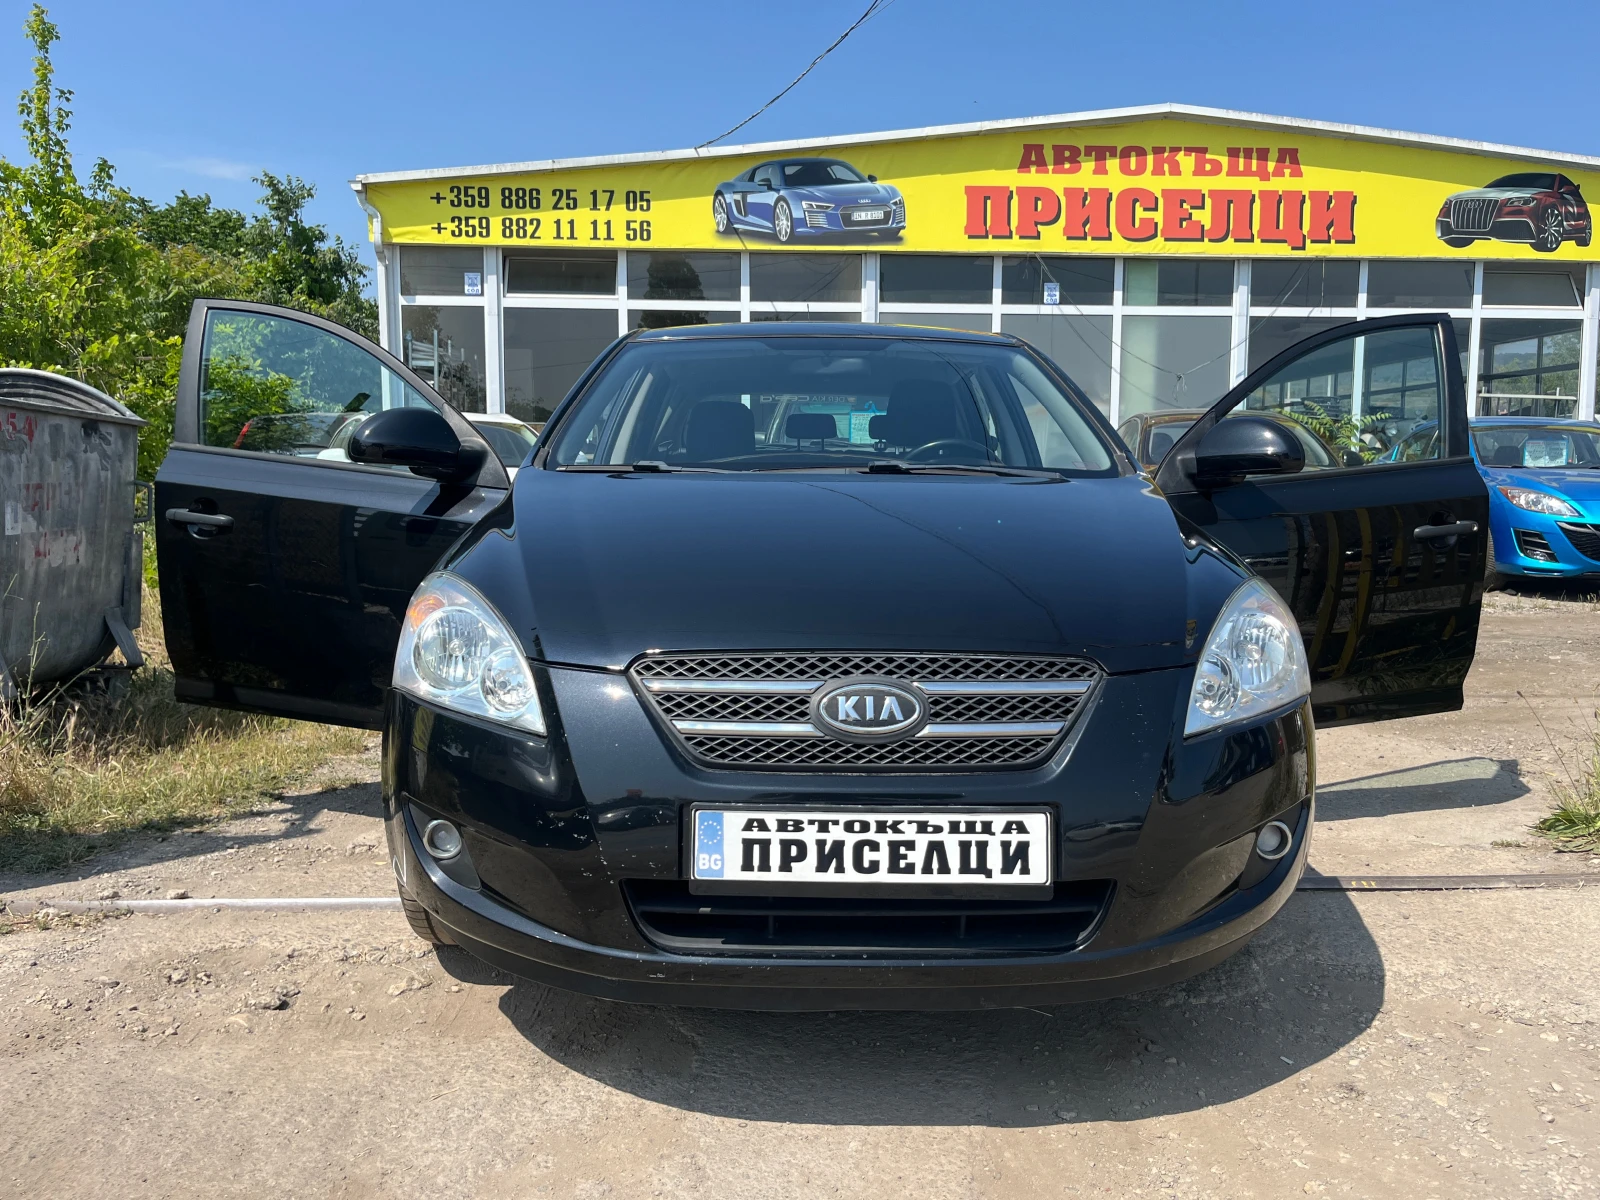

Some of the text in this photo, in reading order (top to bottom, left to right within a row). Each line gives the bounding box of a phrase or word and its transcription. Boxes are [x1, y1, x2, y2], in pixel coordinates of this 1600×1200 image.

[1017, 144, 1303, 182] АВТОКЪЩА
[430, 186, 651, 212] +359 886 25 17 05
[431, 216, 651, 242] +359 882 11 11 56
[964, 186, 1357, 250] ПРИСЕЛЦИ
[837, 695, 905, 721] KIA
[740, 817, 1031, 837] АВТОКЪЩА
[699, 853, 722, 870] BG
[740, 837, 1031, 878] ПРИСЕЛЦИ
